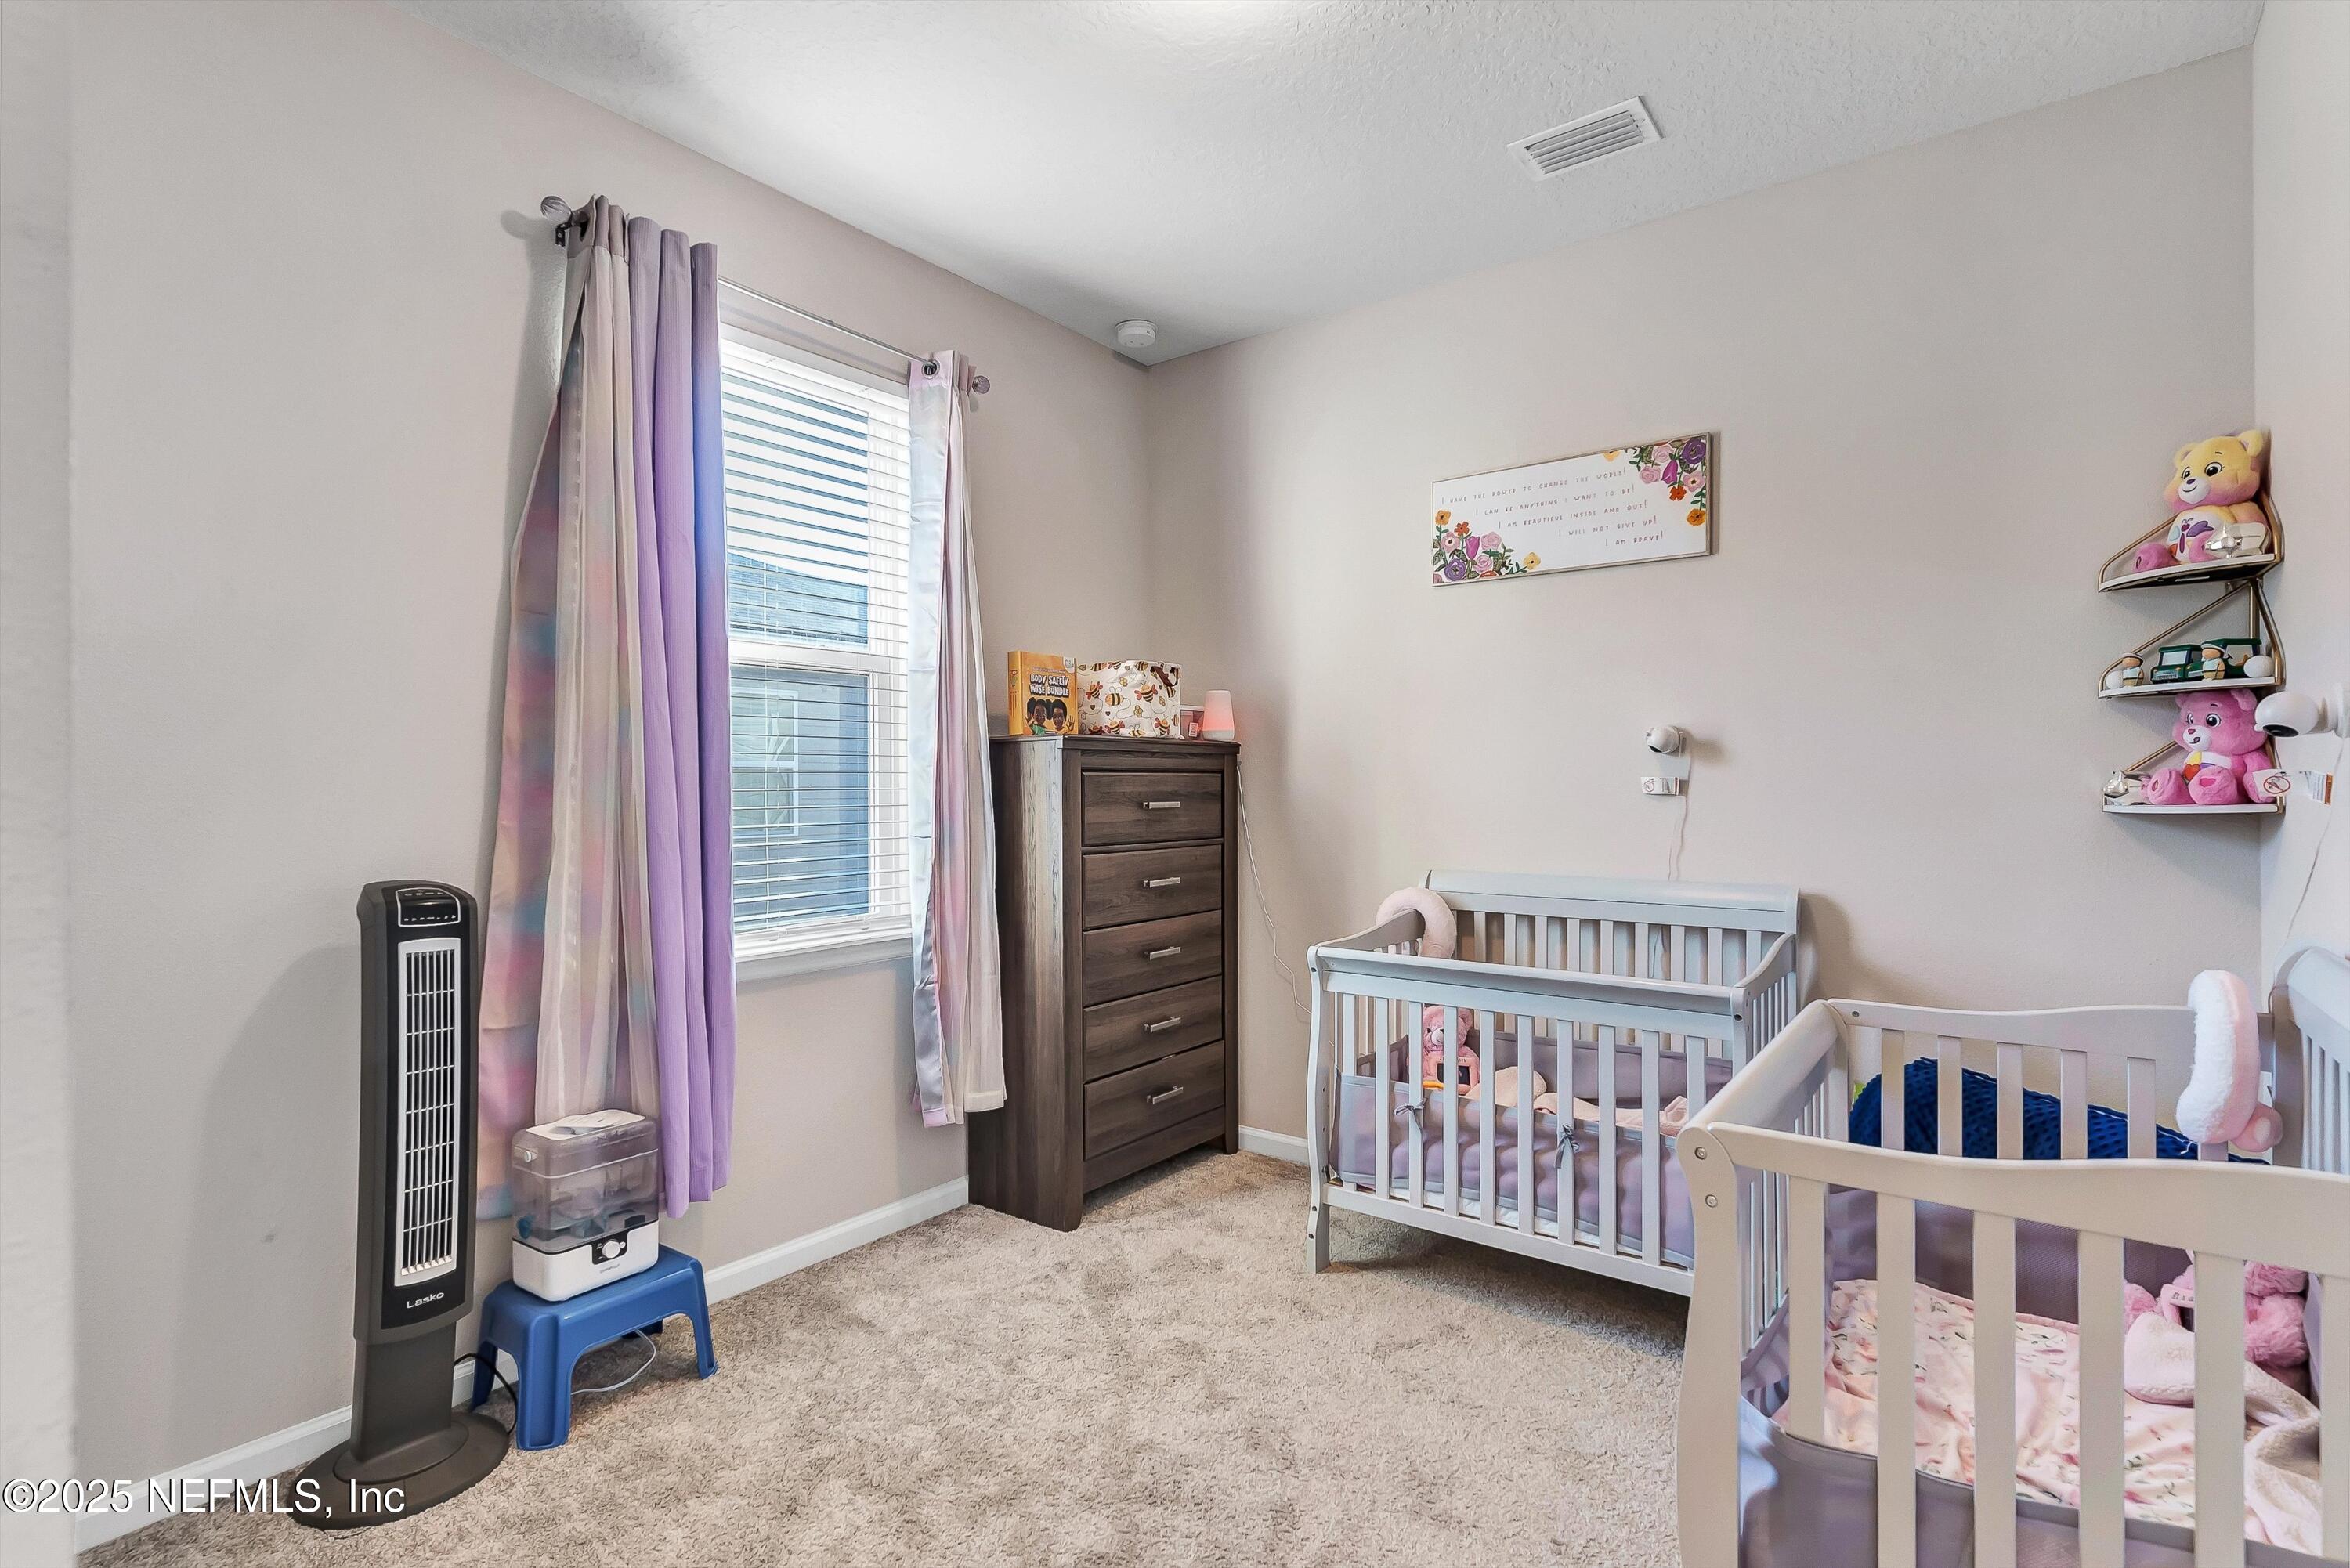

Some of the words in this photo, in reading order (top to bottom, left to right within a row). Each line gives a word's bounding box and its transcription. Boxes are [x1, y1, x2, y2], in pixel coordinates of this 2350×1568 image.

[1491, 488, 1517, 497] POWER
[1538, 479, 1567, 489] CHANGE
[1596, 466, 1626, 479] WORLD!
[1519, 499, 1558, 509] ANYTHING
[1574, 493, 1596, 501] WANT
[1524, 515, 1563, 526] BEAUTIFUL
[1570, 510, 1597, 518] INSIDE
[1626, 499, 1647, 511] OUT!
[1643, 515, 1657, 526] UP!
[1633, 530, 1663, 543] BRAVE!
[1030, 674, 1046, 684] BODY
[1048, 675, 1068, 686] SAFETY
[1030, 684, 1046, 694] WISE
[1047, 686, 1069, 695] BUNDLE
[407, 1292, 444, 1309] Lasko
